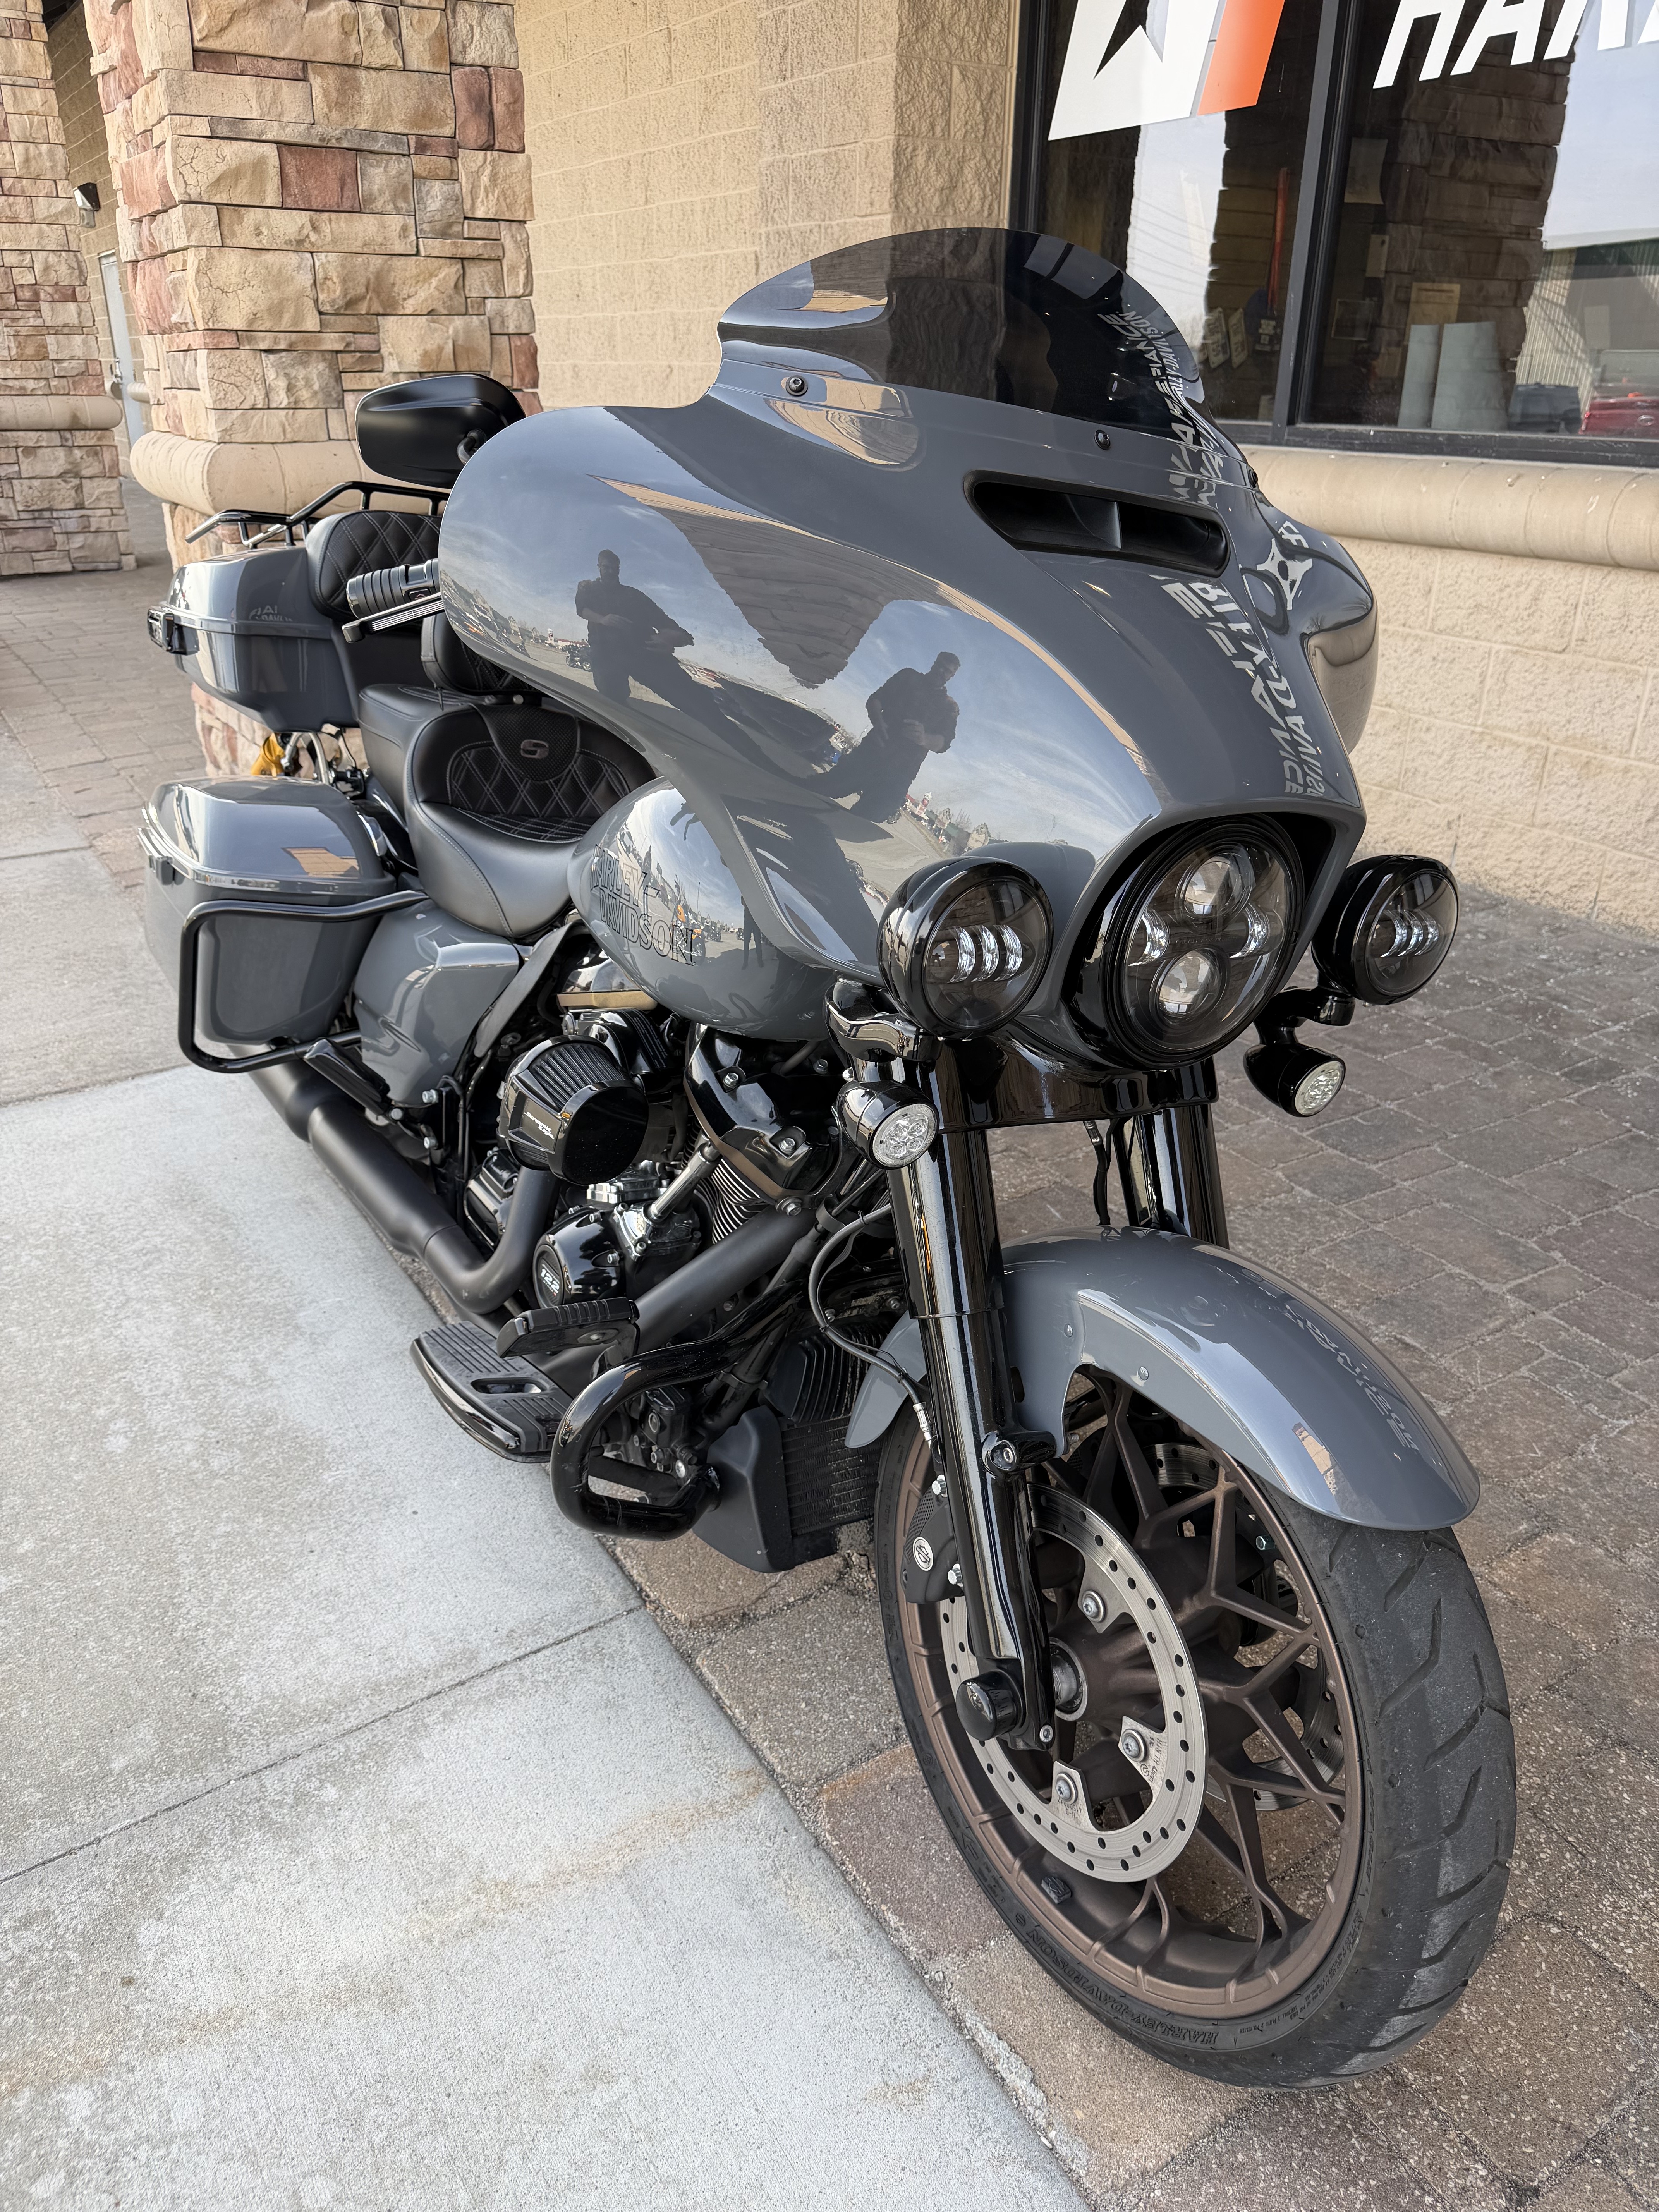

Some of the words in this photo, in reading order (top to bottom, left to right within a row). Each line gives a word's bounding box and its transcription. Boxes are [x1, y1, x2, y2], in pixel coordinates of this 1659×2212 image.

[599, 887, 696, 966] DAVIDSON
[541, 1268, 560, 1293] 122
[1026, 1927, 1219, 2045] HARLEY-DAVIDSON
